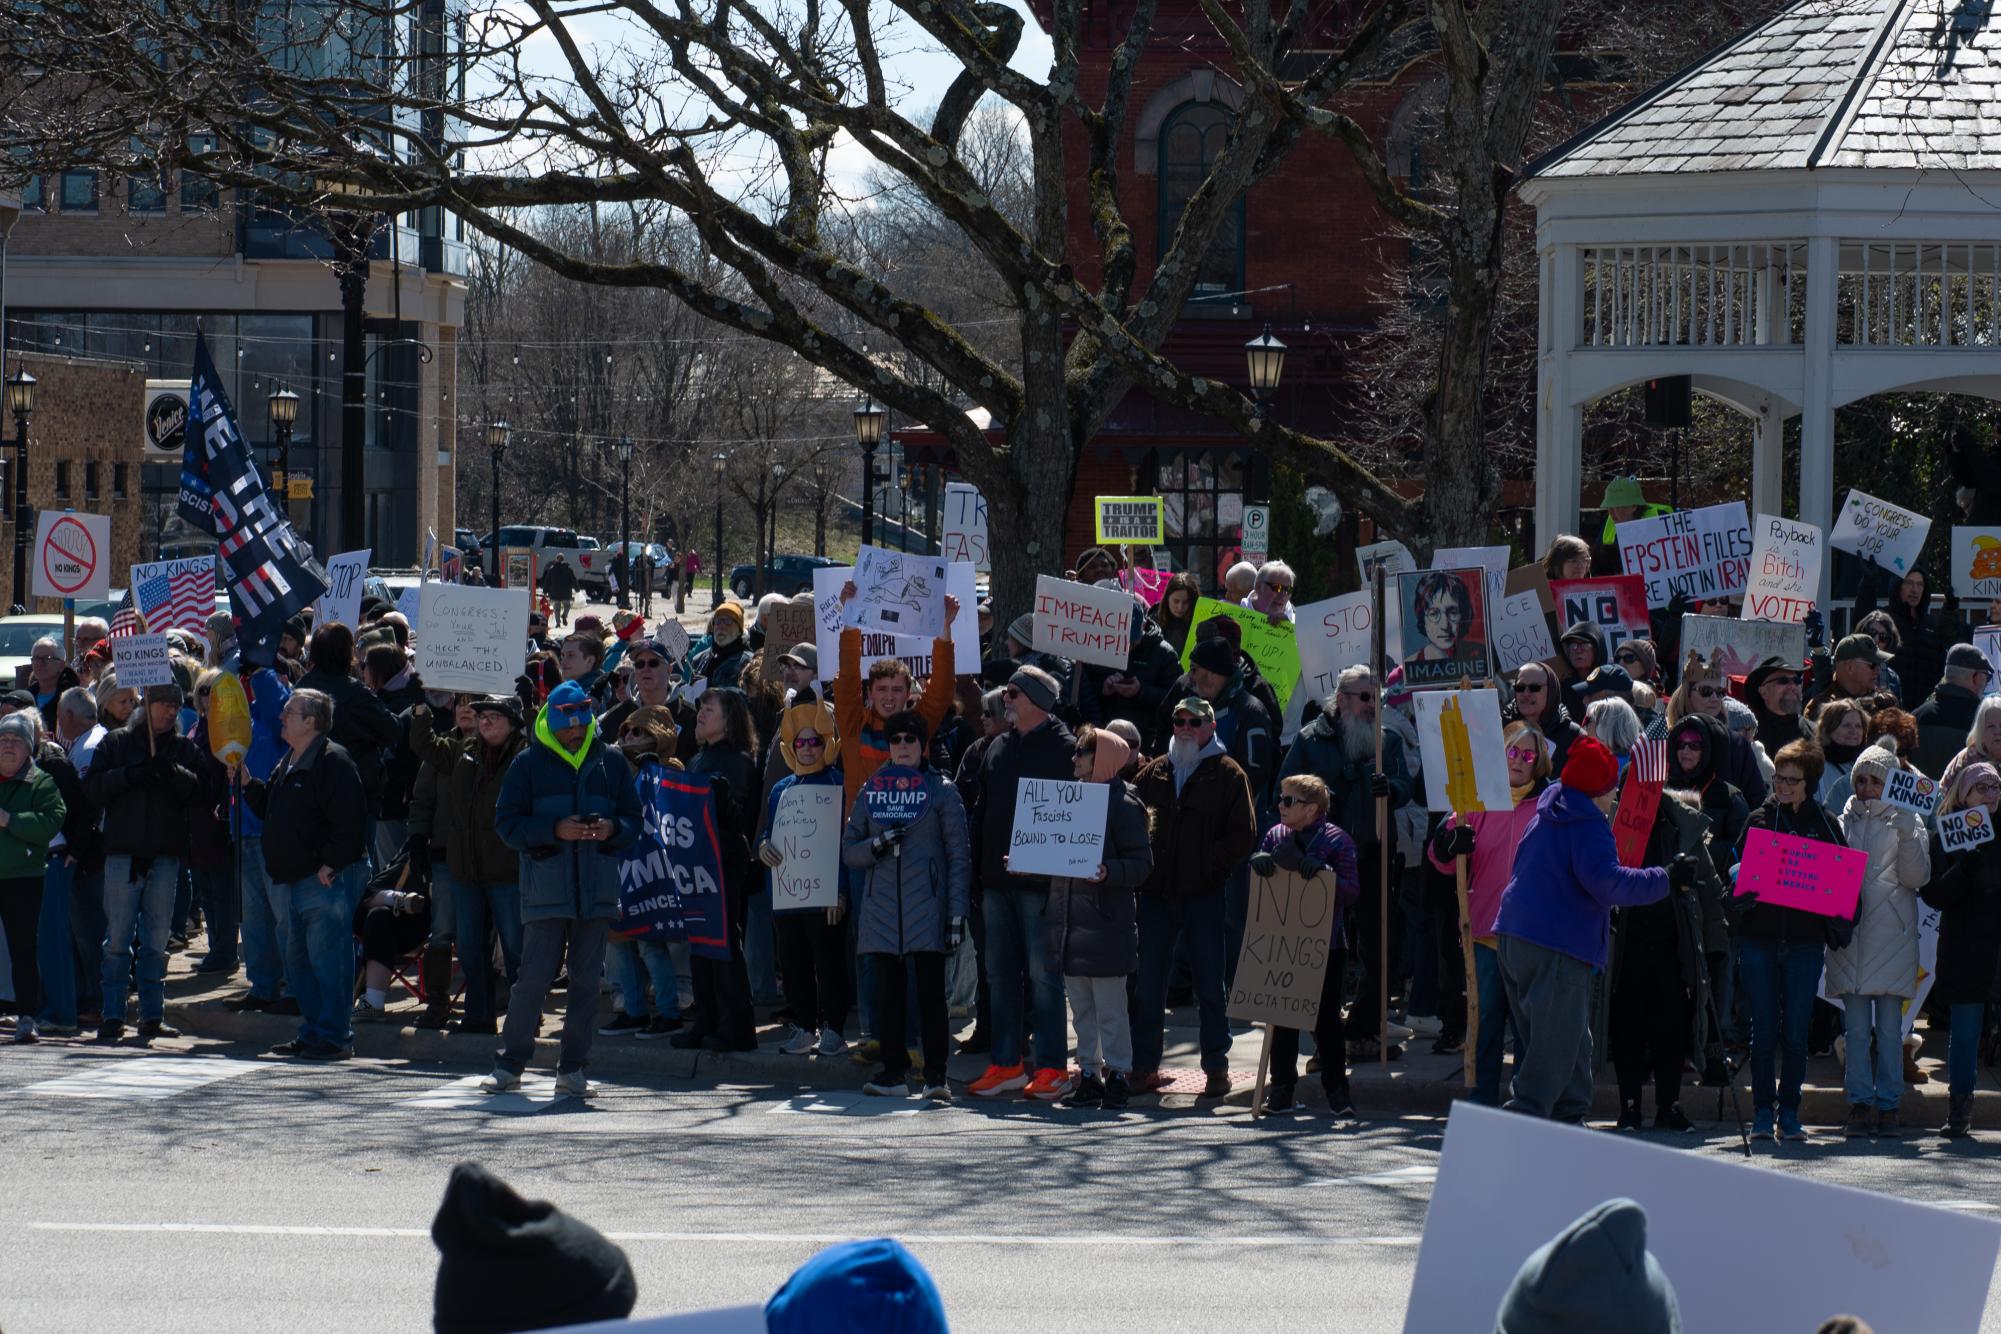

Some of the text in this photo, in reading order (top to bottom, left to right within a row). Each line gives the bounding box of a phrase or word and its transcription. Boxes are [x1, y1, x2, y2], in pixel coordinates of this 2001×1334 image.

[154, 405, 184, 440] Venice
[1103, 503, 1157, 515] TRUMP
[1120, 516, 1140, 524] IS A
[1864, 502, 1914, 529] CONGRESS:
[1103, 525, 1157, 538] TRAITOR
[1659, 511, 1696, 536] THE
[1770, 520, 1815, 546] Payback
[1854, 513, 1901, 541] DO YOUR
[1623, 528, 1753, 576] EPSTEIN FILES
[1857, 535, 1884, 554] JOB
[55, 563, 81, 573] NO KINGS
[136, 558, 210, 581] NO KINGS
[1763, 553, 1805, 580] Bitch
[325, 562, 361, 600] STOP
[1667, 572, 1697, 599] NOT
[1699, 568, 1716, 593] IN
[1758, 577, 1784, 589] and
[1037, 594, 1130, 631] IMPEACH
[1565, 596, 1619, 628] NO
[134, 637, 164, 646] AMERICA
[1047, 624, 1130, 657] TRUMP!!
[1499, 624, 1539, 649] OUT
[117, 648, 164, 661] NO KINGS
[472, 647, 499, 657] THE
[1503, 638, 1548, 668] NOW
[1409, 660, 1487, 680] IMAGINE
[1892, 771, 1914, 789] NO
[816, 792, 833, 805] be
[866, 791, 927, 805] TRUMP
[1023, 780, 1084, 805] ALL YOU
[1888, 785, 1934, 810] KINGS
[872, 811, 918, 819] DEMOCRACY
[886, 804, 905, 812] SAVE
[1032, 804, 1073, 824] Fascists
[776, 814, 817, 838] Turkey
[1941, 816, 1963, 833] NO
[1944, 824, 1991, 847] KINGS
[783, 835, 811, 861] No
[1012, 829, 1102, 847] BOUND TO LOSE
[776, 866, 821, 901] Kings
[628, 894, 677, 916] SINCE
[1256, 872, 1328, 929] NO
[1243, 932, 1327, 970] KINGS
[1264, 969, 1294, 989] NO
[1233, 989, 1318, 1017] DICTATORS
